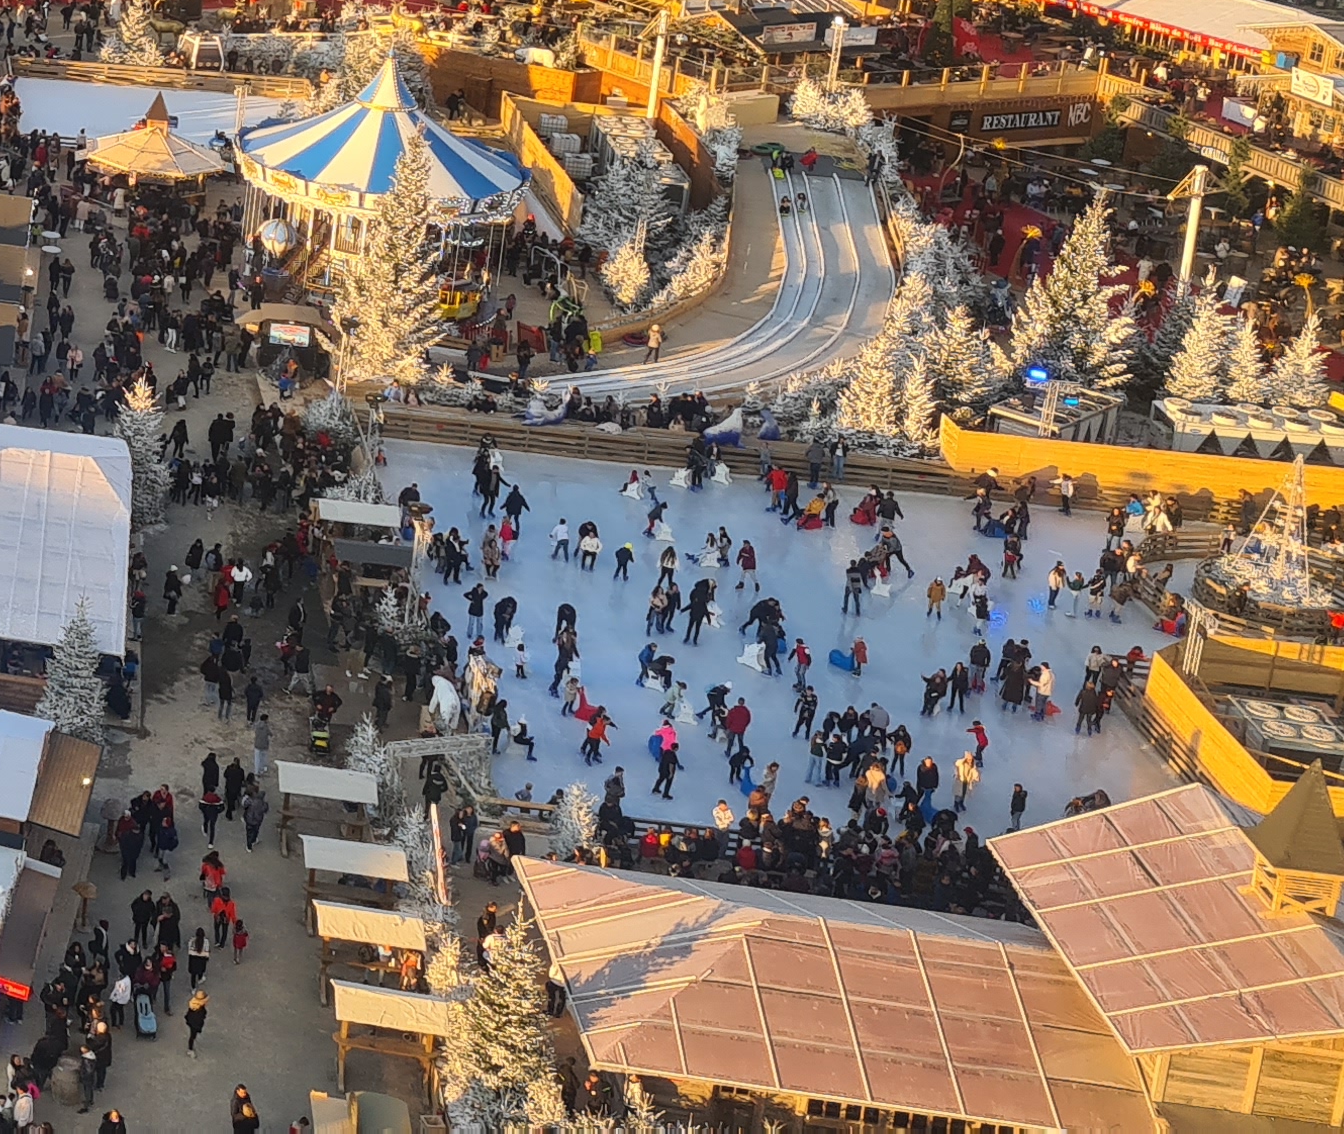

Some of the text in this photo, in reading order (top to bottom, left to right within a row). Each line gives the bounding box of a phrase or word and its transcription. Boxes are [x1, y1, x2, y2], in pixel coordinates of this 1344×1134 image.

[1208, 36, 1224, 48] Bar
[981, 111, 1061, 131] RESTAURANT
[1067, 102, 1092, 127] NBC
